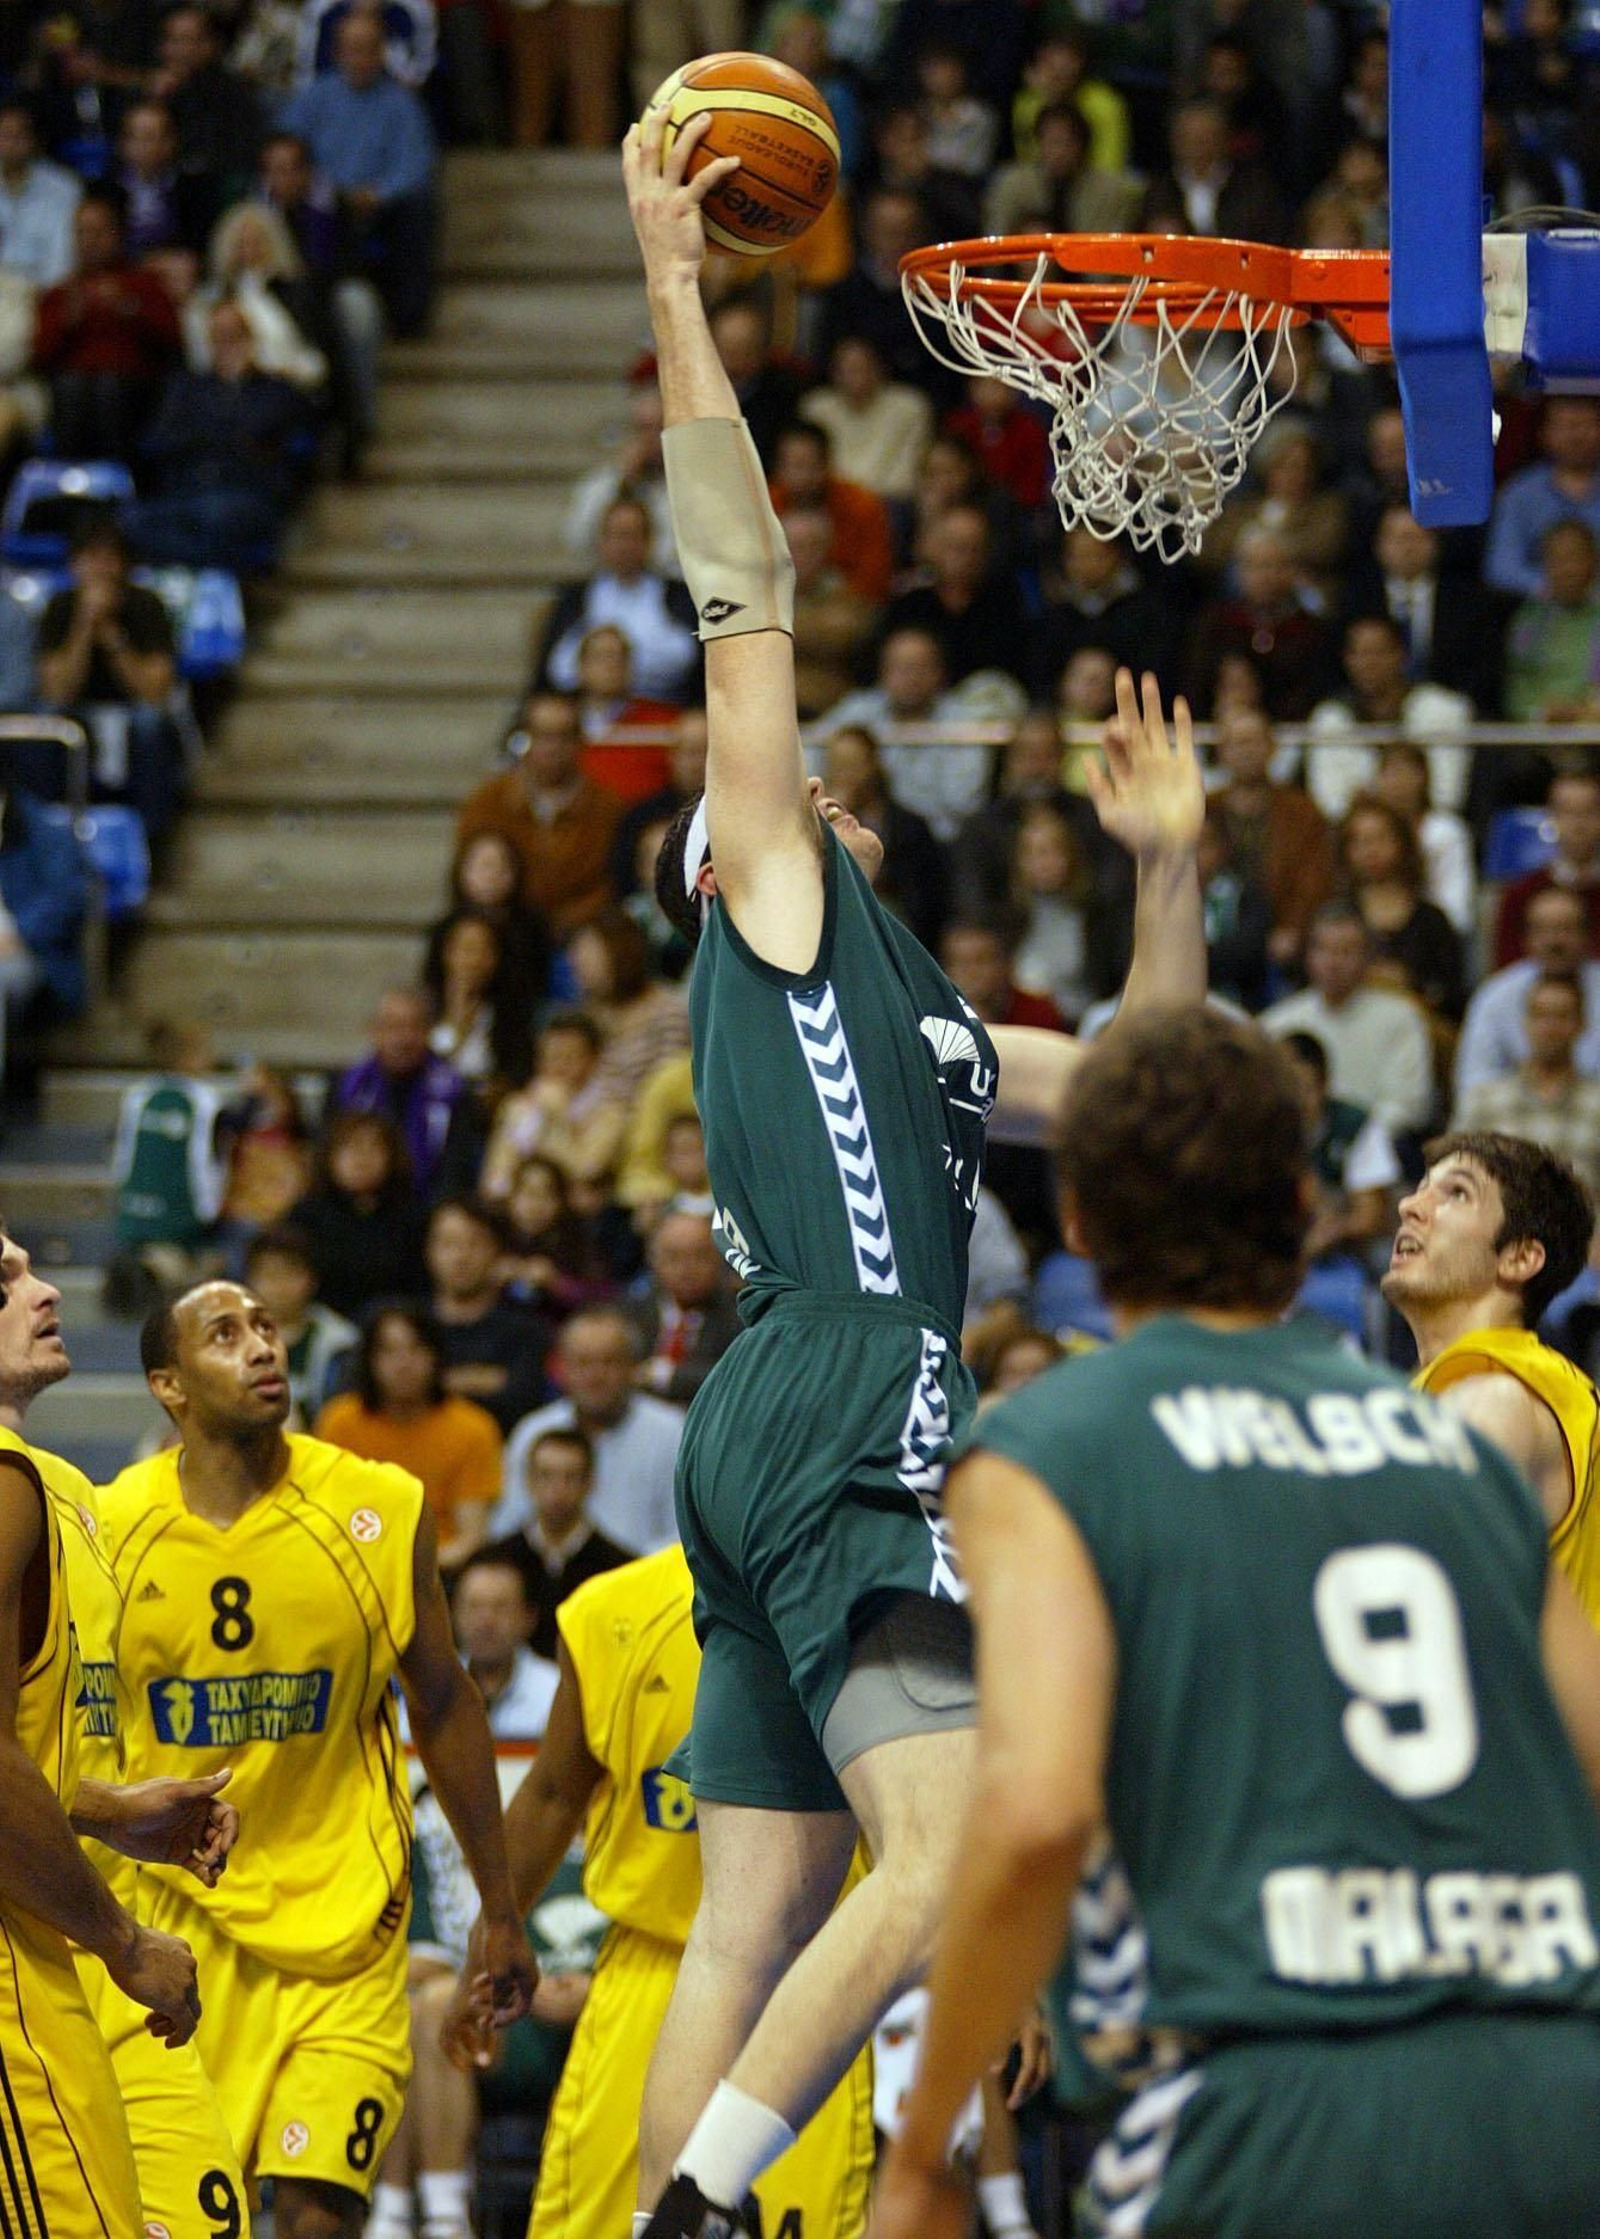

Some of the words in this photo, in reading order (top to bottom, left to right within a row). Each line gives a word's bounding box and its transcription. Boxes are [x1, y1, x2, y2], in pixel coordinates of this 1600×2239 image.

[1151, 1385, 1481, 1478] WELSCH
[210, 1575, 254, 1652] 8
[1313, 1542, 1480, 1799] 9
[345, 2097, 385, 2172] 8
[197, 2168, 241, 2239] 9
